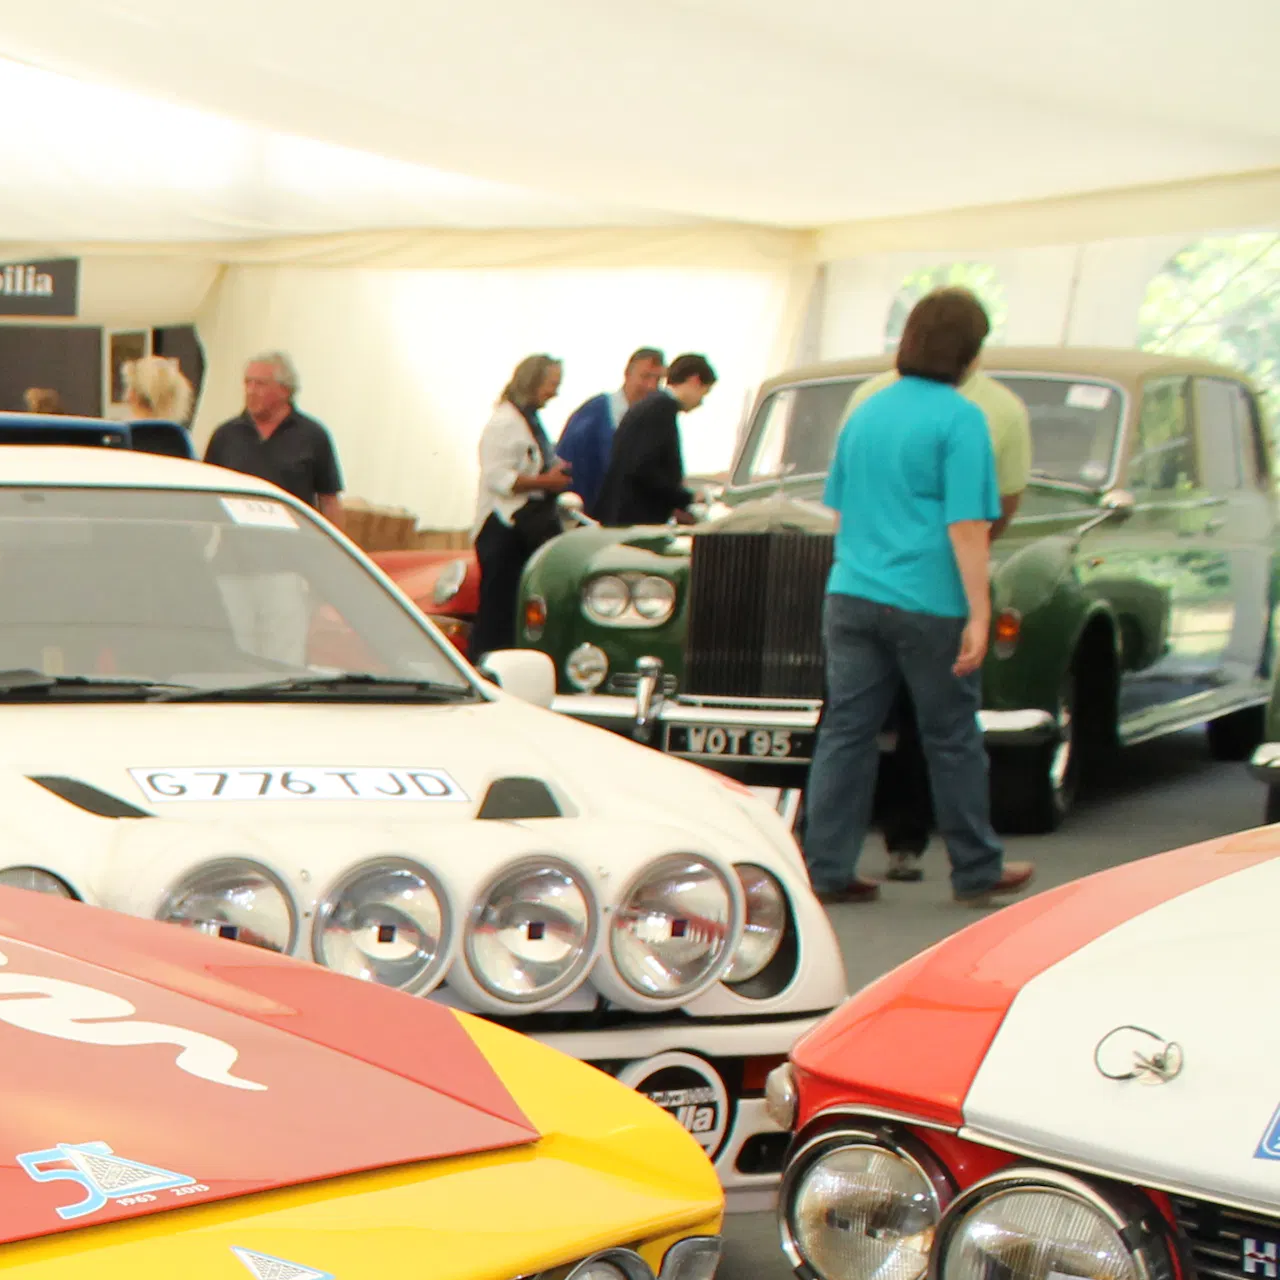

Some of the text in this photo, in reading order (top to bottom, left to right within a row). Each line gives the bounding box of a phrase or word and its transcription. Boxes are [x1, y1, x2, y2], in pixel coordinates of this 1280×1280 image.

[688, 727, 791, 757] WOT 95
[146, 771, 453, 797] G776 TJD
[675, 1104, 715, 1133] lla
[116, 1184, 210, 1206] 1963 2013
